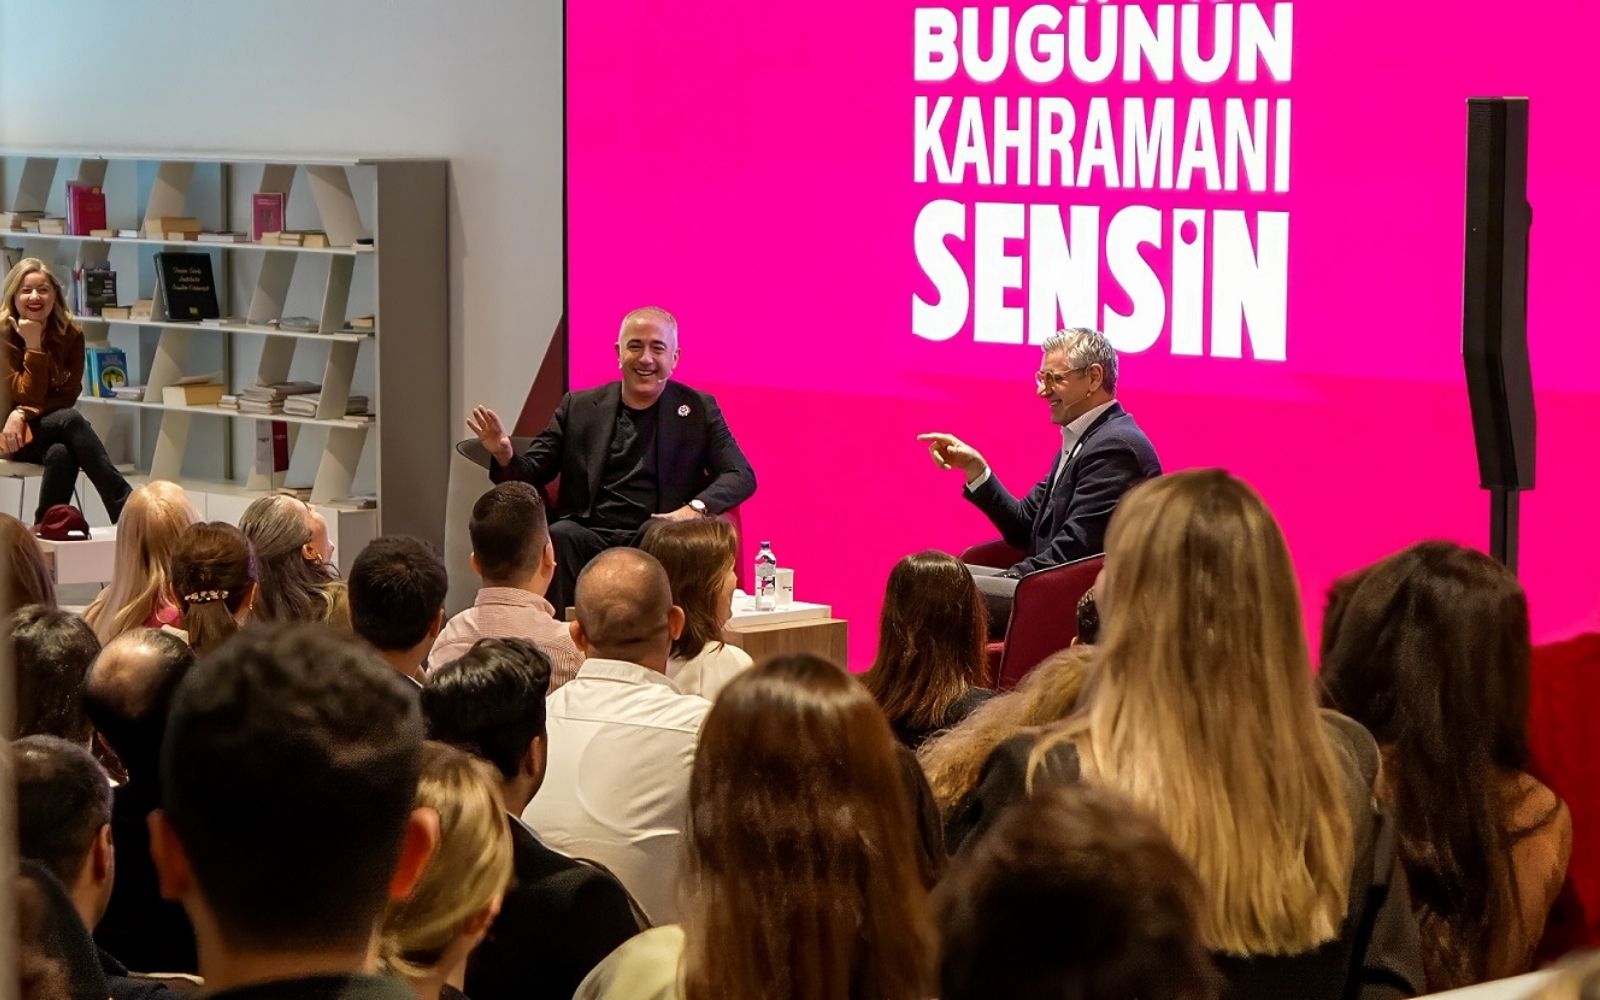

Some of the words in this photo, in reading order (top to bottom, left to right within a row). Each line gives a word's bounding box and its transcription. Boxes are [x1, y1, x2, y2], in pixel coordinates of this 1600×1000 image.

[914, 0, 1294, 83] BUGÜNÜN
[914, 96, 1291, 193] KAHRAMANI
[912, 199, 1290, 361] SENSİN
